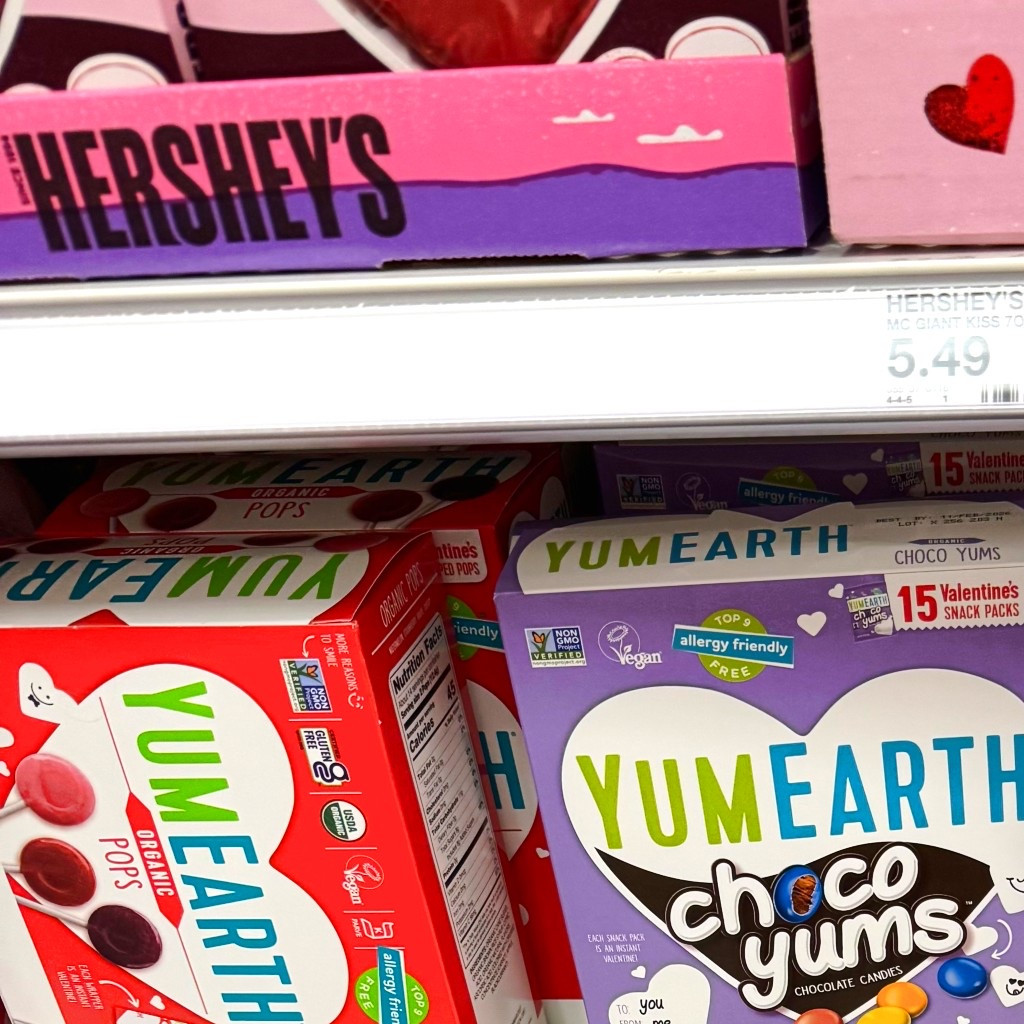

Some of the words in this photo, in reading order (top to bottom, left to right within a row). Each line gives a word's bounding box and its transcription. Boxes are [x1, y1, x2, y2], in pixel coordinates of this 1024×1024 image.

[12, 113, 408, 253] HERSHEY'S
[887, 291, 1024, 313] HERSHEY'S
[887, 318, 910, 330] MC
[916, 317, 962, 330] GIANT
[967, 315, 1000, 329] KISS
[887, 335, 991, 378] 5.49
[124, 456, 517, 487] YUMEARTH
[930, 451, 964, 487] 15
[969, 472, 997, 485] SNACK
[251, 487, 330, 499] ORGANIC
[244, 501, 305, 520] POPS
[545, 523, 849, 573] YUMEARTH
[894, 548, 948, 565] CHOCO
[956, 547, 1002, 561] YUMS
[897, 585, 938, 623] 15
[939, 580, 1020, 603] Valentine's
[944, 605, 981, 620] SNACK
[985, 603, 1020, 619] PACKS
[714, 613, 741, 627] TOP
[555, 629, 578, 638] NON
[556, 637, 580, 645] GMO
[533, 651, 583, 660] VERIFIED
[680, 634, 729, 652] allergy
[732, 637, 788, 657] friendly
[392, 649, 426, 696] Nutrition
[424, 623, 443, 656] Facts
[709, 660, 751, 679] FREE
[122, 680, 304, 1024] YUMEARTH
[136, 829, 175, 898] ORGANIC
[98, 837, 144, 892] POPS
[738, 895, 962, 1011] yums
[383, 952, 397, 999] allergy
[794, 977, 856, 998] CHOCOLATE
[859, 965, 904, 985] CANDIES
[639, 997, 665, 1016] you
